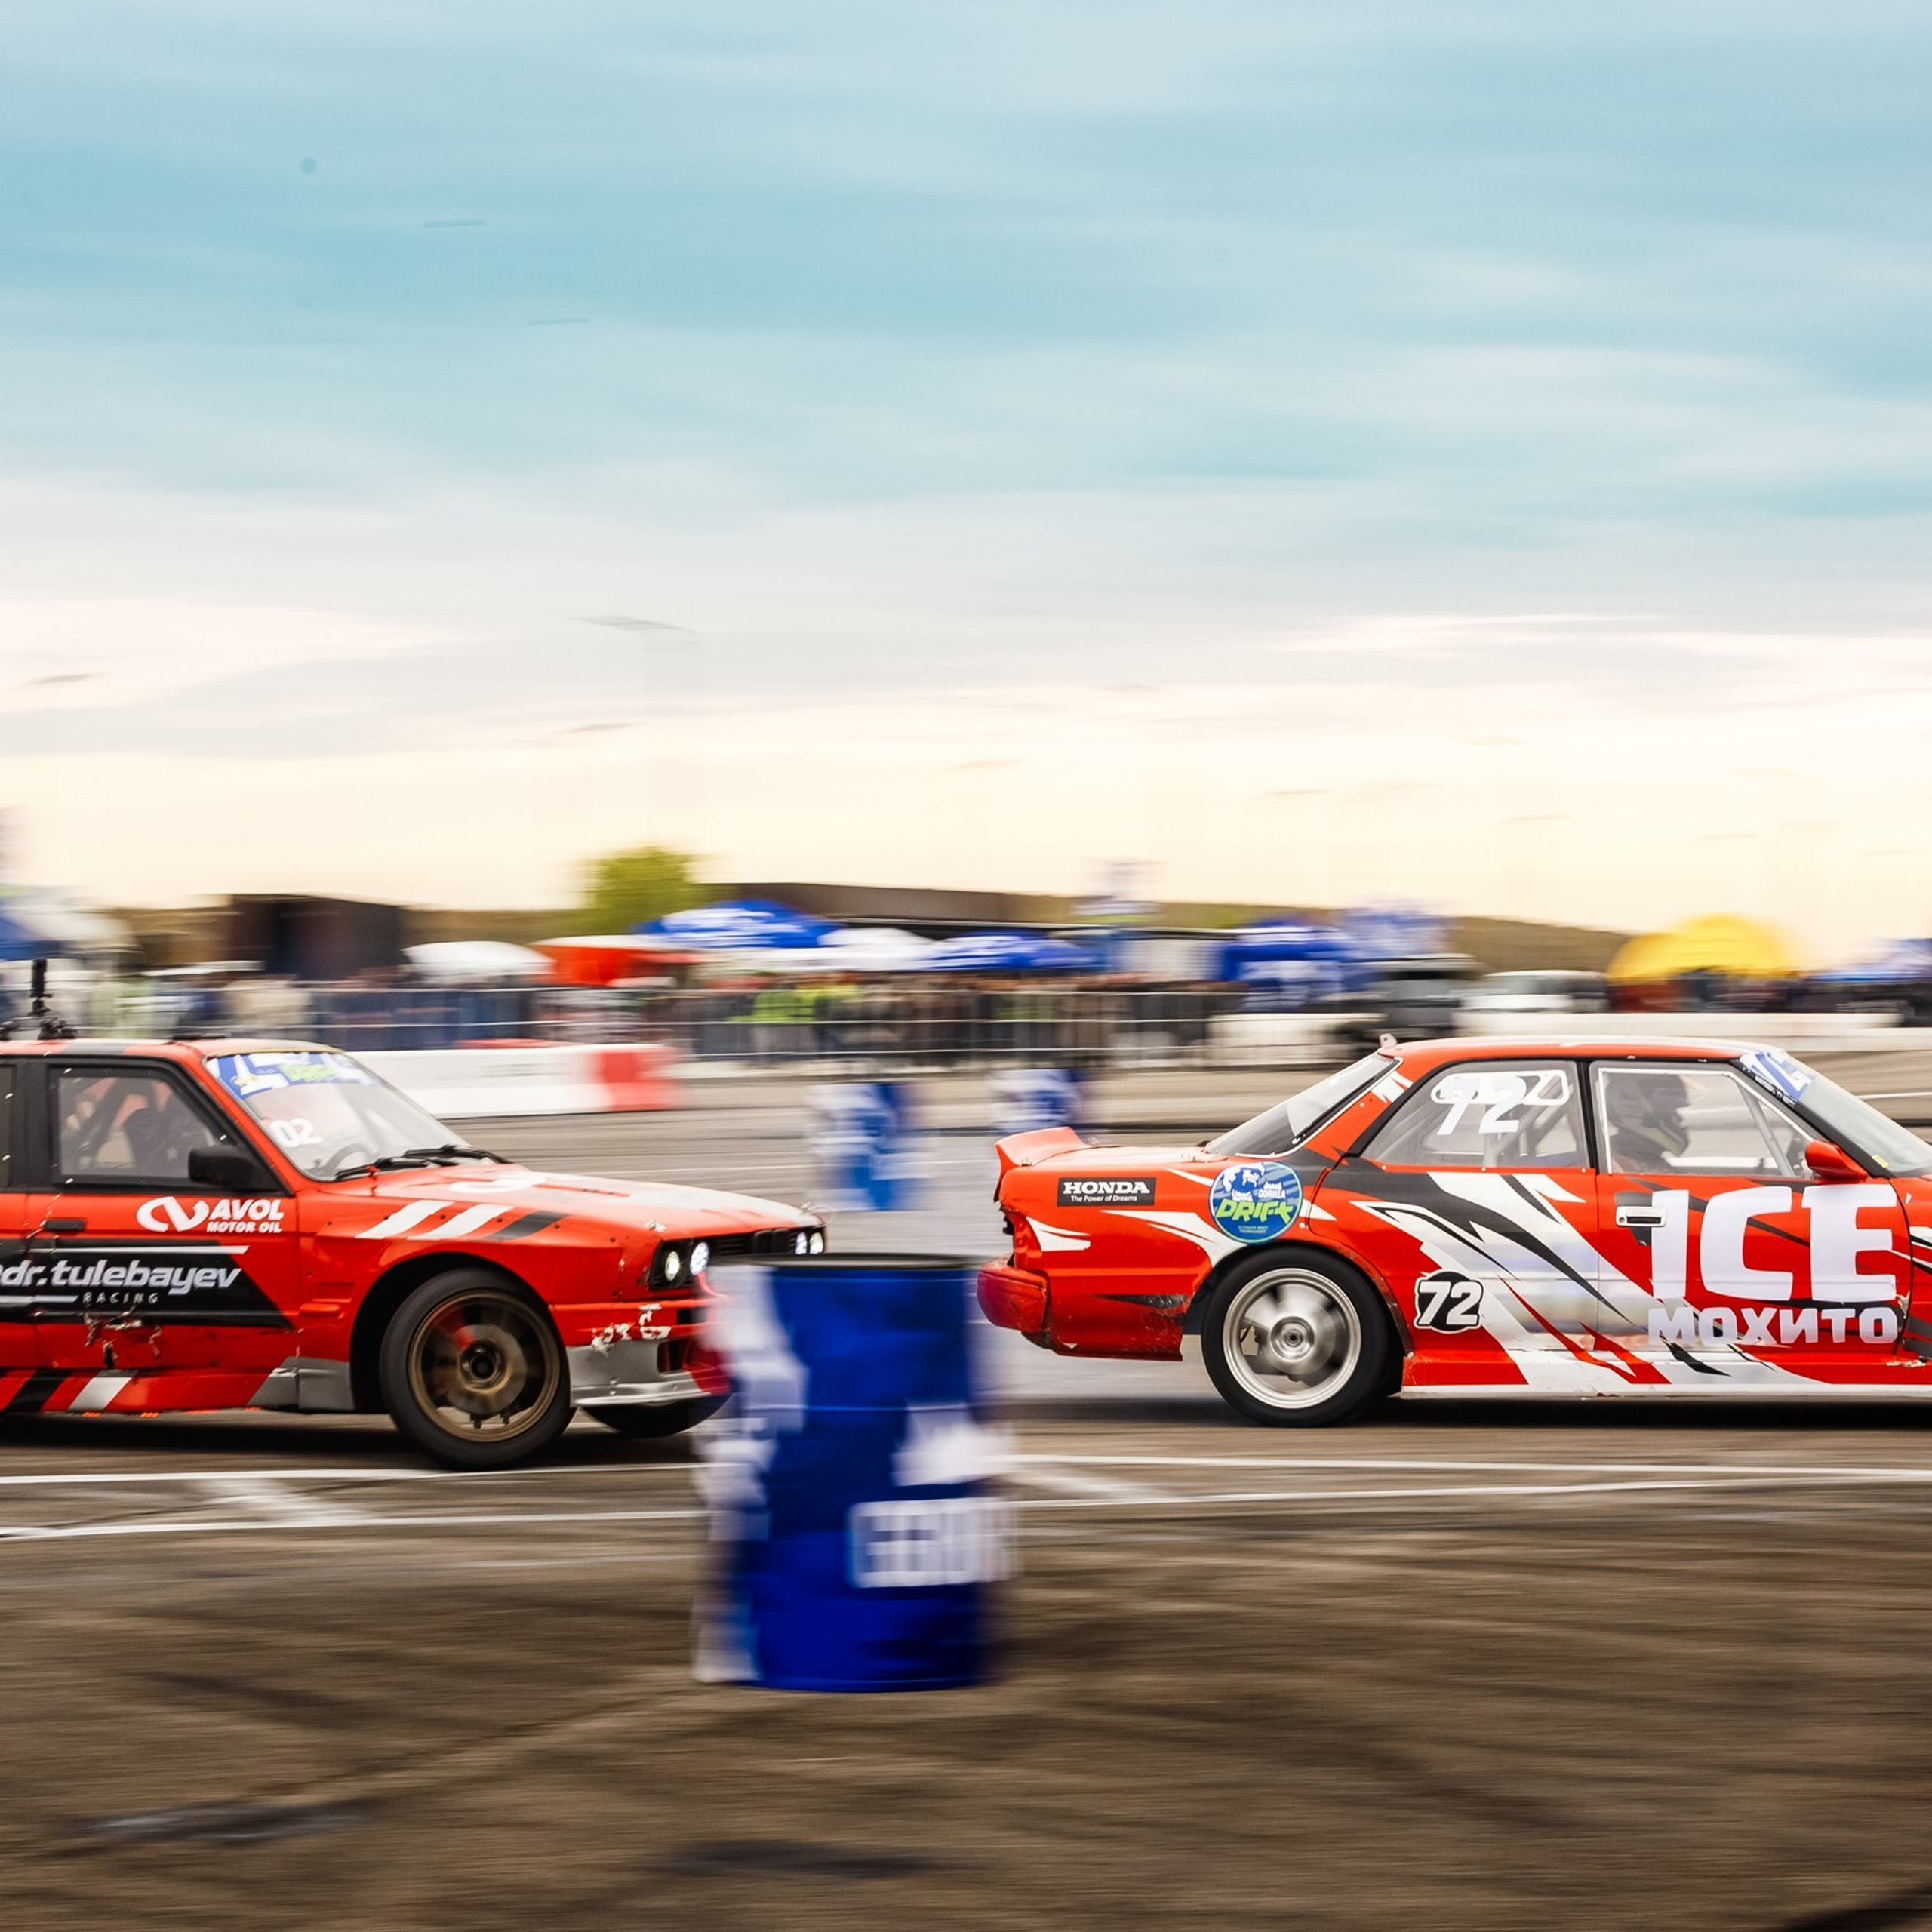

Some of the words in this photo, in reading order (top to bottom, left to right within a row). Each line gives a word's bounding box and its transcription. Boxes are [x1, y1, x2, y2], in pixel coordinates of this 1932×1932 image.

[1439, 1075, 1527, 1135] 72
[269, 1118, 324, 1148] 02
[1063, 1181, 1150, 1194] HONDA
[1258, 1189, 1286, 1199] GORILLA
[208, 1199, 284, 1220] AVOL
[1215, 1198, 1294, 1224] DRIFT
[206, 1221, 255, 1233] MOTOR
[258, 1222, 283, 1233] OIL
[1651, 1184, 1897, 1302] ICE
[0, 1260, 242, 1295] dr.tulebayev
[82, 1292, 159, 1303] RACING
[1418, 1281, 1482, 1325] 72
[1647, 1307, 1898, 1346] МОХИТО
